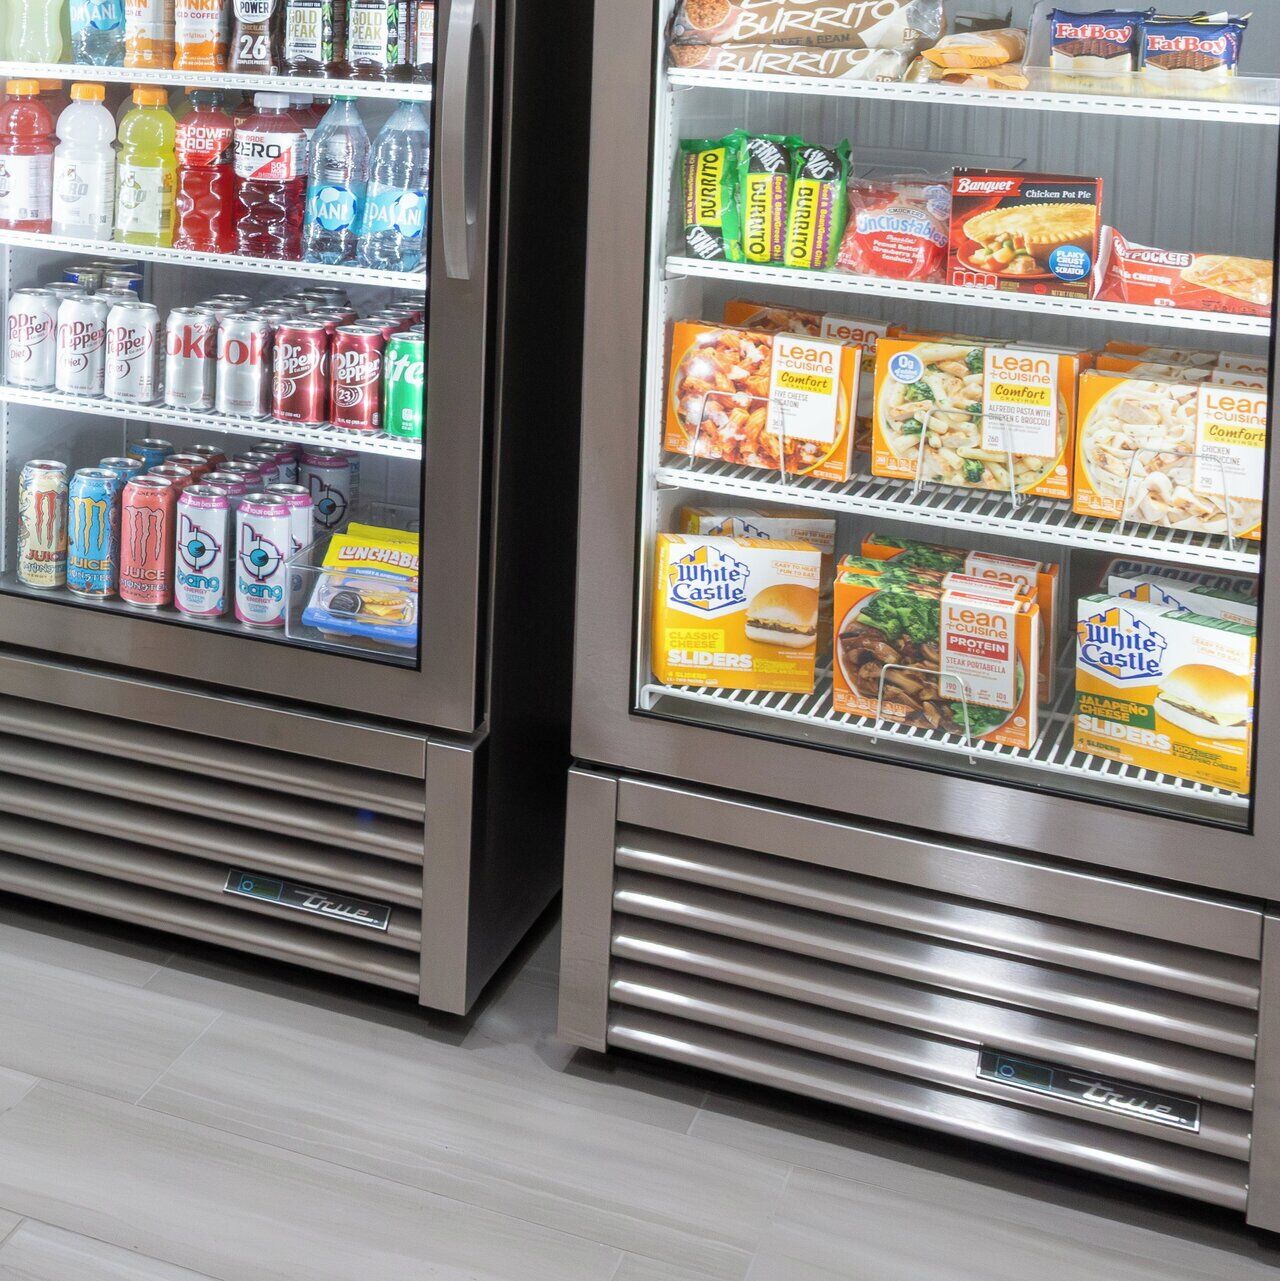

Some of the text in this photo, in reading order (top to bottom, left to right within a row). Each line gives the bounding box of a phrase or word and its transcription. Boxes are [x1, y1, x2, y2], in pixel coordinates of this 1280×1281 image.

[240, 1, 269, 15] POWER
[352, 10, 383, 26] GOLD
[289, 23, 318, 38] PEAK
[352, 24, 382, 40] PEAK
[1056, 23, 1132, 44] FatBoy
[1147, 34, 1227, 55] FatBoy
[701, 152, 719, 219] BURRITO
[957, 177, 1014, 194] Banquet
[1025, 189, 1091, 199] Chicken Pot Pie
[857, 214, 948, 247] Uncrustables
[1056, 250, 1085, 259] FLAKY
[19, 314, 37, 326] Dr
[781, 371, 828, 389] Comfort
[995, 384, 1045, 400] Comfort
[70, 558, 111, 571] JUICE
[124, 566, 166, 581] JUICE
[178, 567, 219, 592] bang
[678, 564, 741, 586] White
[673, 582, 745, 602] Castle
[669, 631, 721, 641] CLASSIC
[669, 640, 717, 650] CHEESE
[950, 635, 1006, 654] PROTEIN
[1085, 621, 1157, 652] White
[667, 650, 753, 668] SLIDERS
[1080, 643, 1160, 675] Castle
[1079, 694, 1149, 718] JALAPEÑO
[1079, 704, 1131, 723] CHEESE
[1077, 714, 1172, 751] SLIDERS
